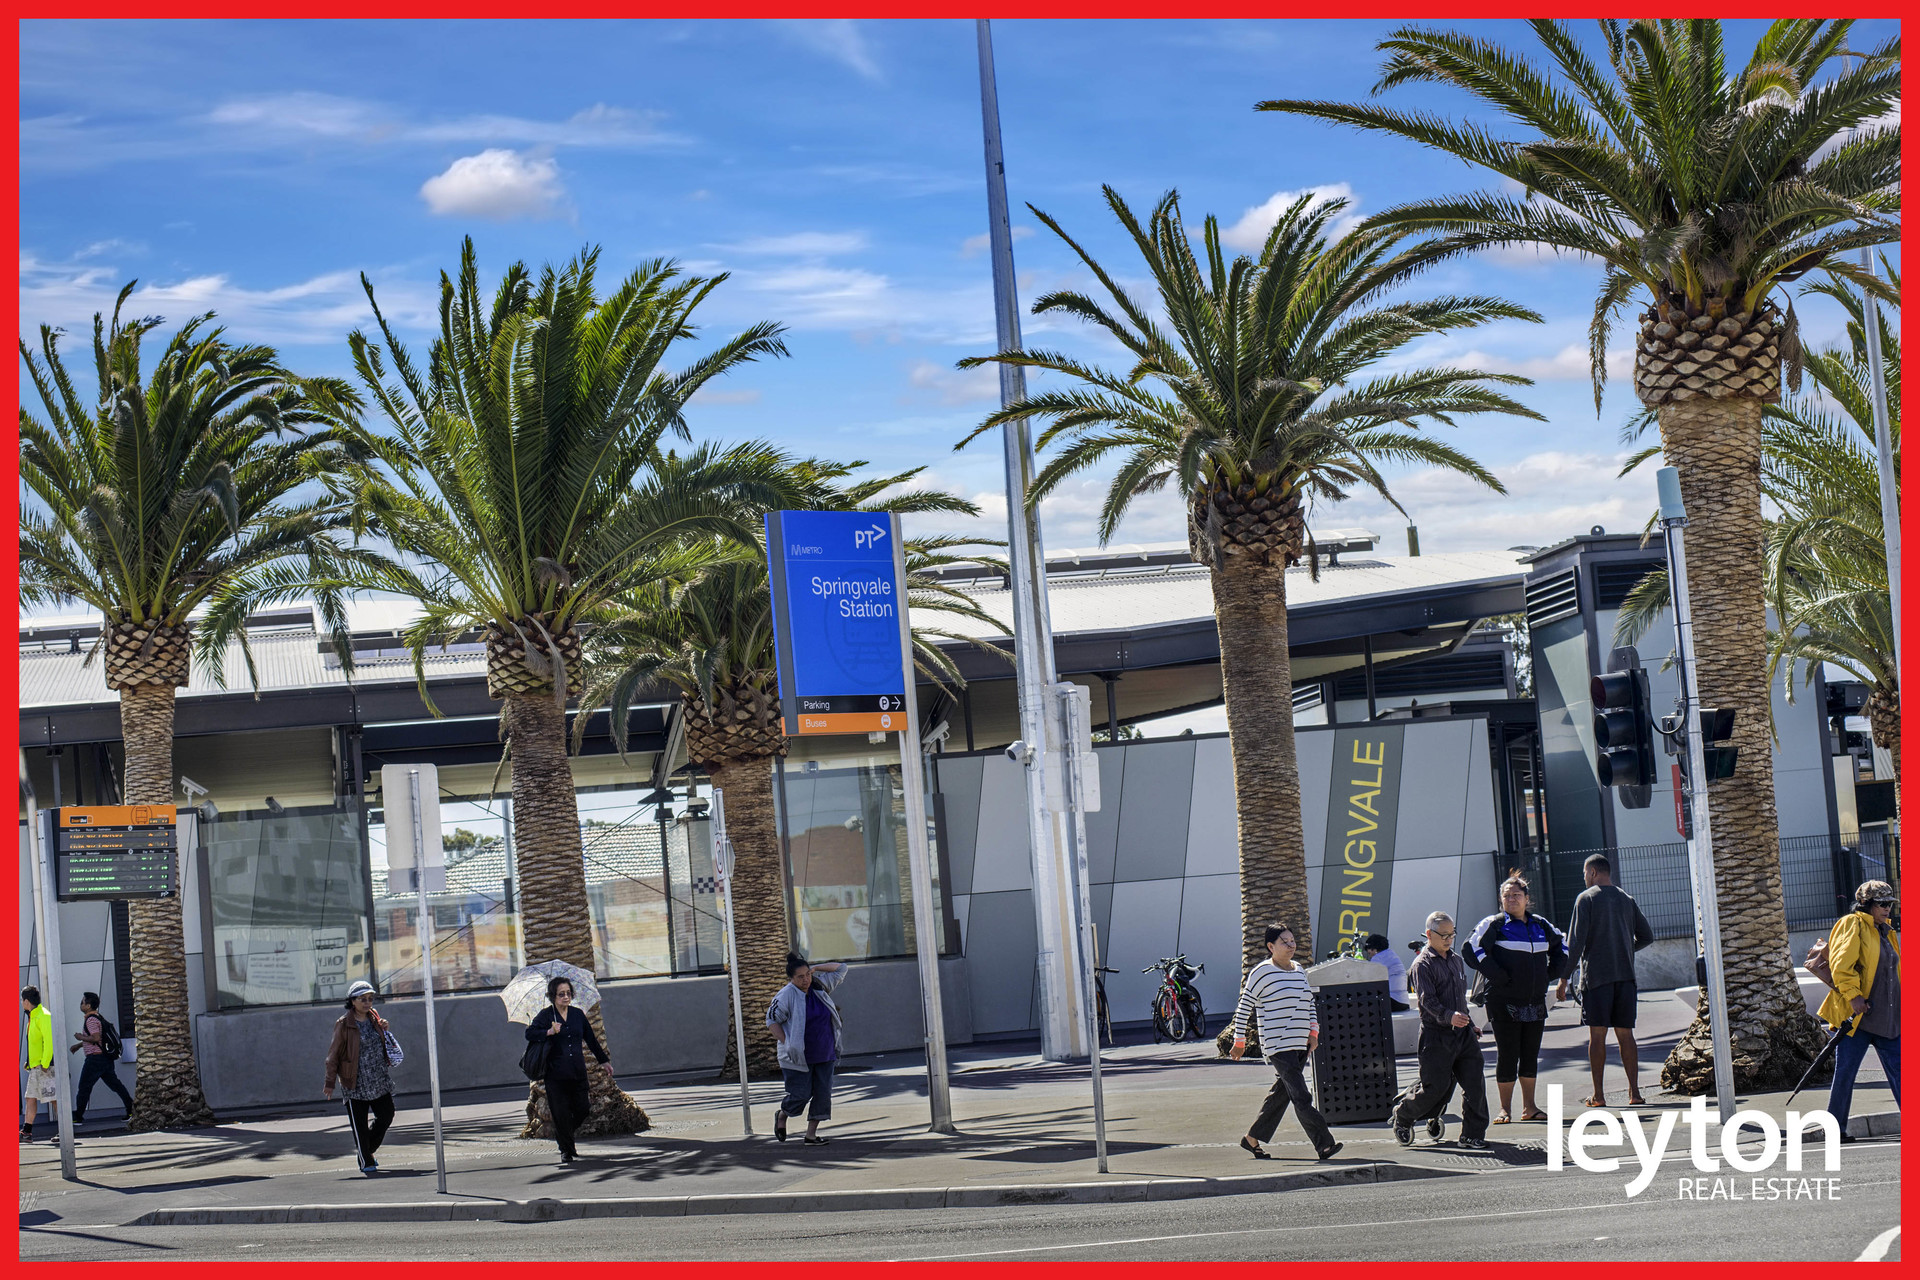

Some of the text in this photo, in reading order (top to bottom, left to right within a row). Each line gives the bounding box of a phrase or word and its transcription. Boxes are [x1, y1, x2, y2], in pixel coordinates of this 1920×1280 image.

[801, 546, 823, 555] METRO
[811, 576, 891, 600] Springvale
[839, 599, 893, 618] Station
[803, 700, 831, 711] Parking
[805, 718, 828, 728] Buses
